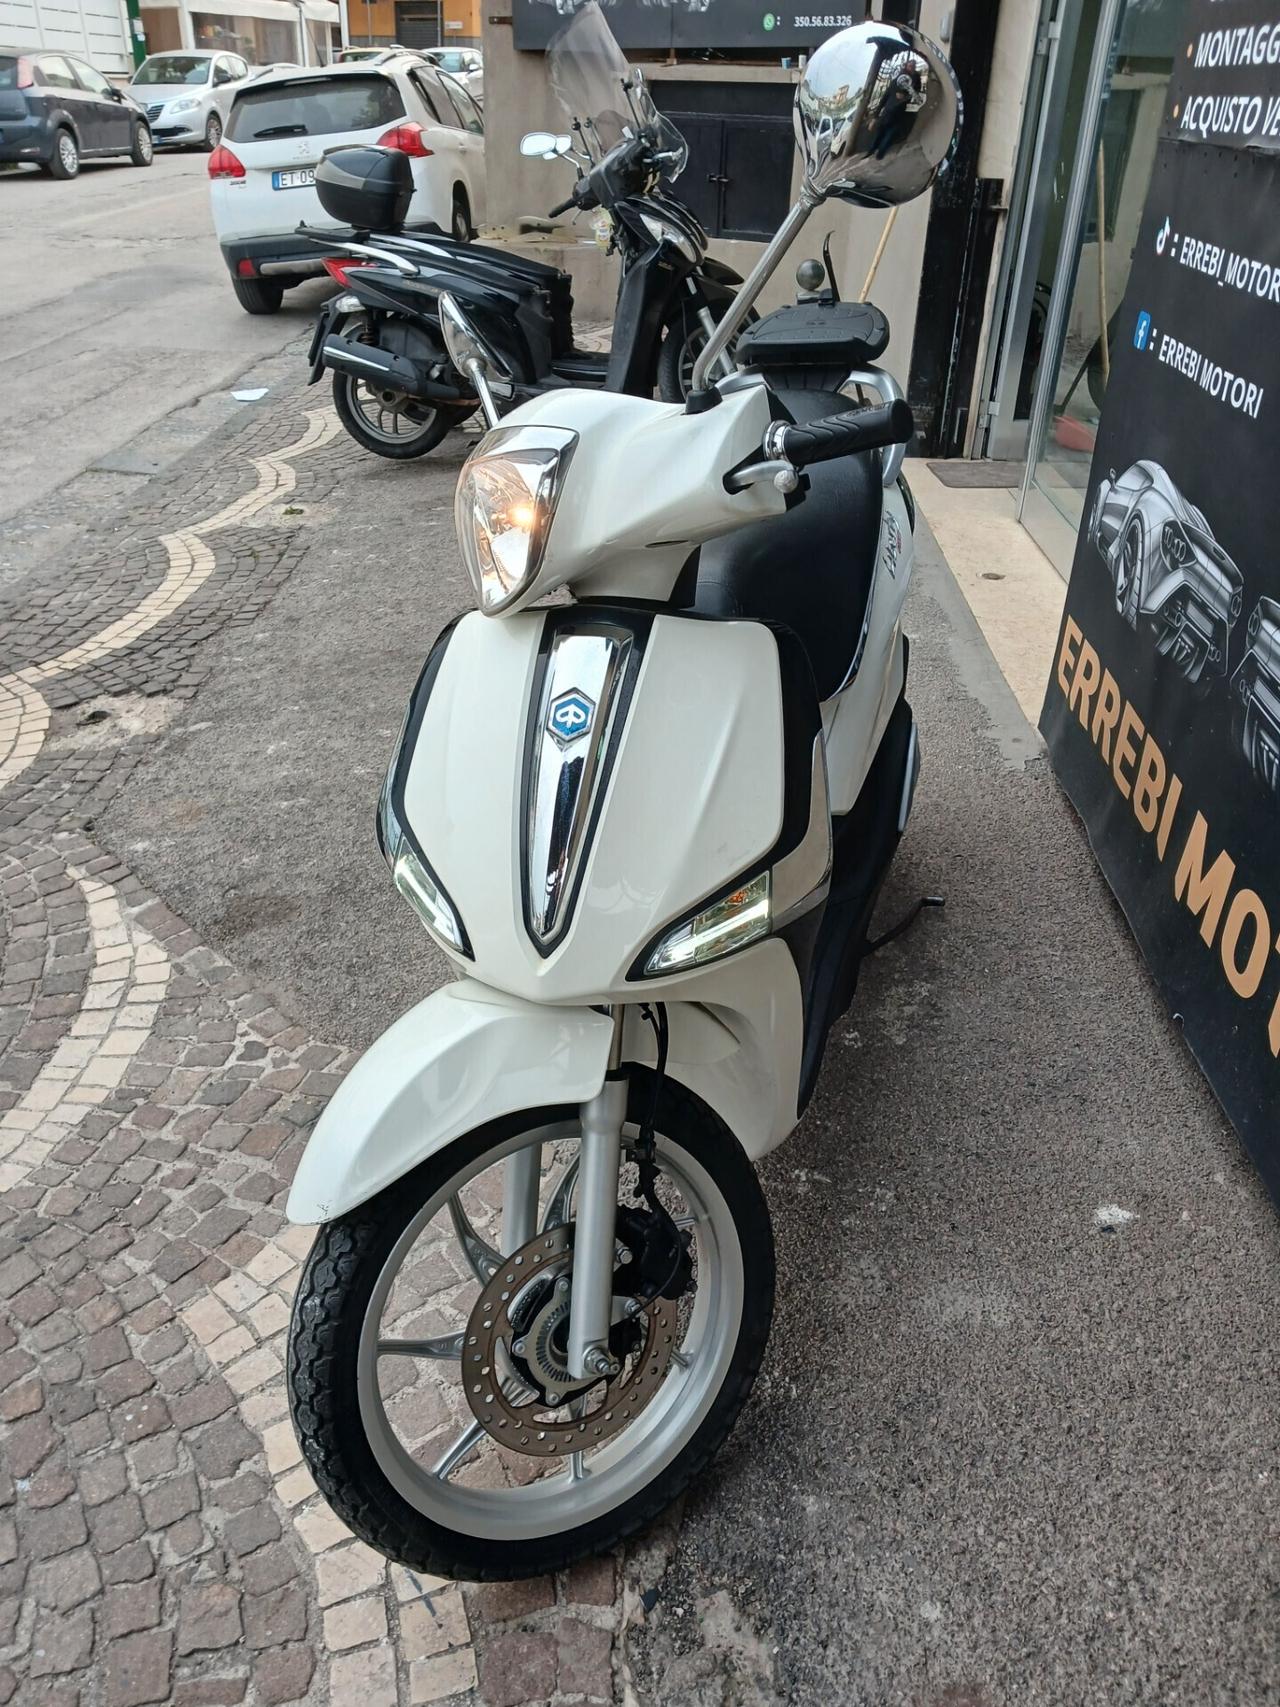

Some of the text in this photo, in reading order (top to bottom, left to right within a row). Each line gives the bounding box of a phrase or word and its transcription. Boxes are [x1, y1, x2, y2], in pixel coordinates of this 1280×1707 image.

[794, 15, 852, 27] 350.56.83.326
[1194, 21, 1280, 68] MONTAGG
[1181, 96, 1280, 139] ACQUISTO VE
[281, 171, 296, 186] ET
[1158, 334, 1202, 381] ERREBI
[1199, 359, 1264, 419] MOTORI
[1058, 614, 1280, 1059] ERREBI MO
